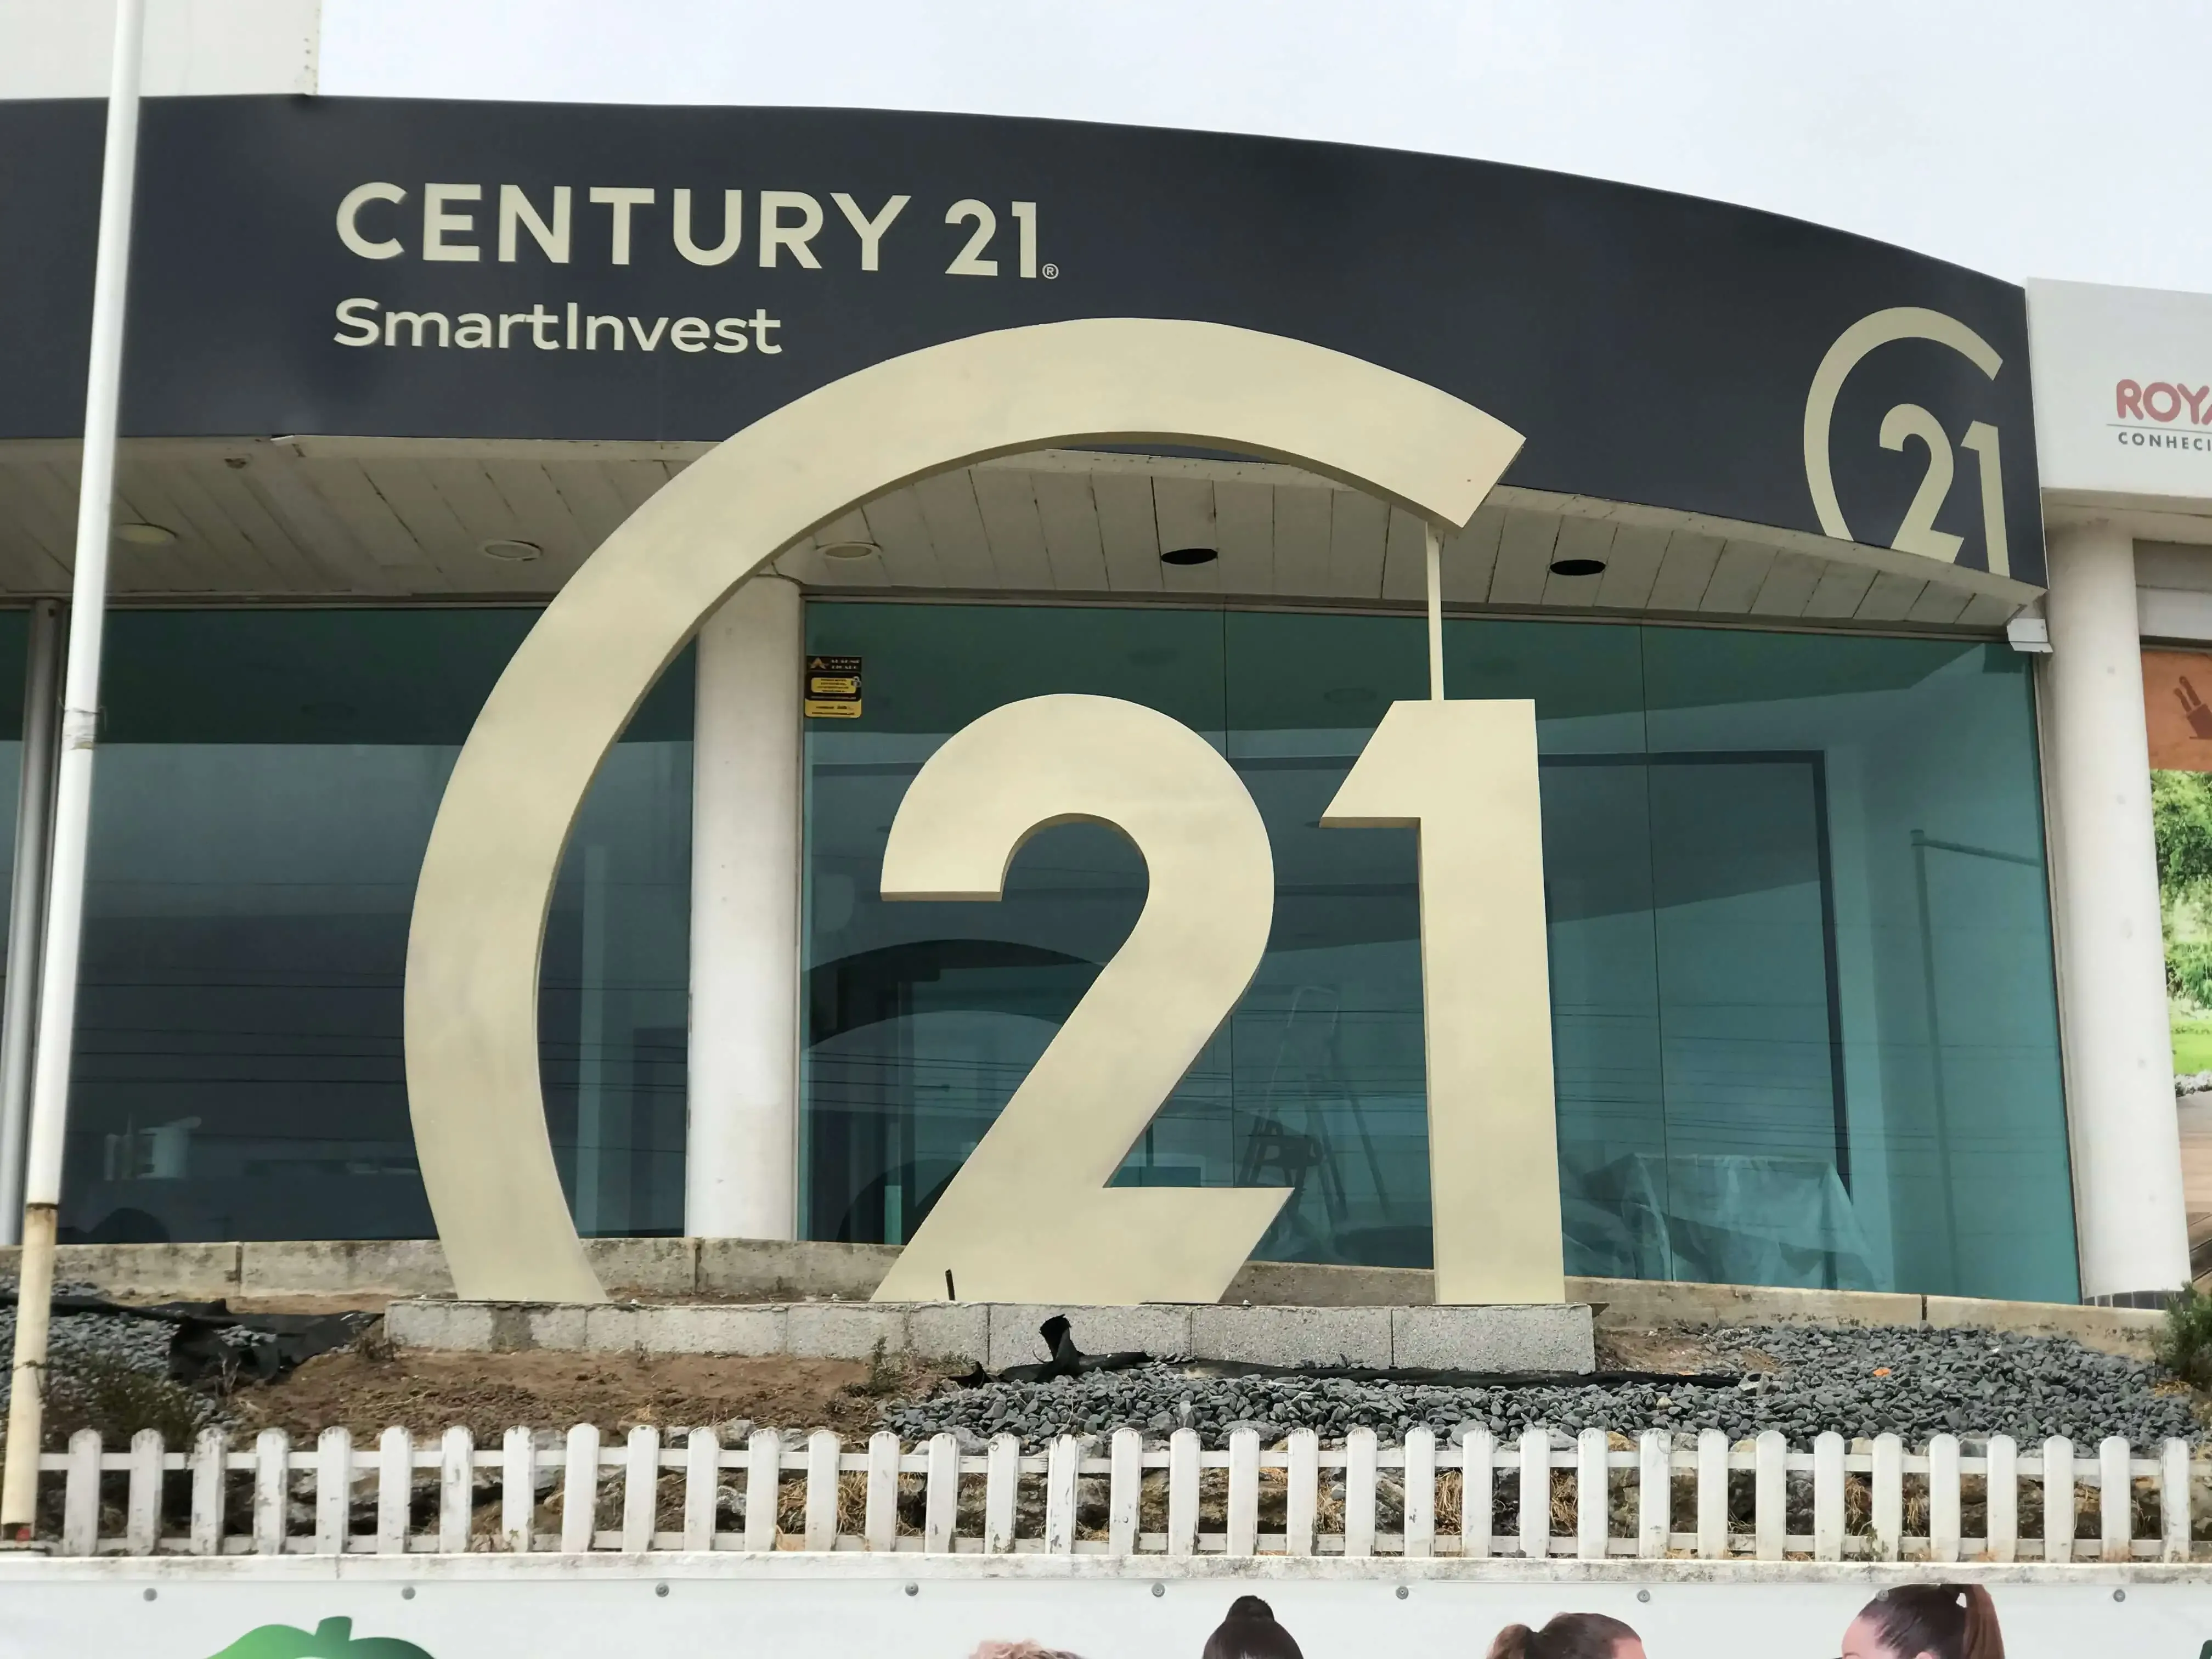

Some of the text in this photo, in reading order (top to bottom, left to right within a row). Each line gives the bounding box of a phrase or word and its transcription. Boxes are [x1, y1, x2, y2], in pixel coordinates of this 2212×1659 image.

[336, 182, 911, 271] CENTURY
[333, 298, 782, 354] SmartInvest
[2118, 432, 2211, 452] CONHECI
